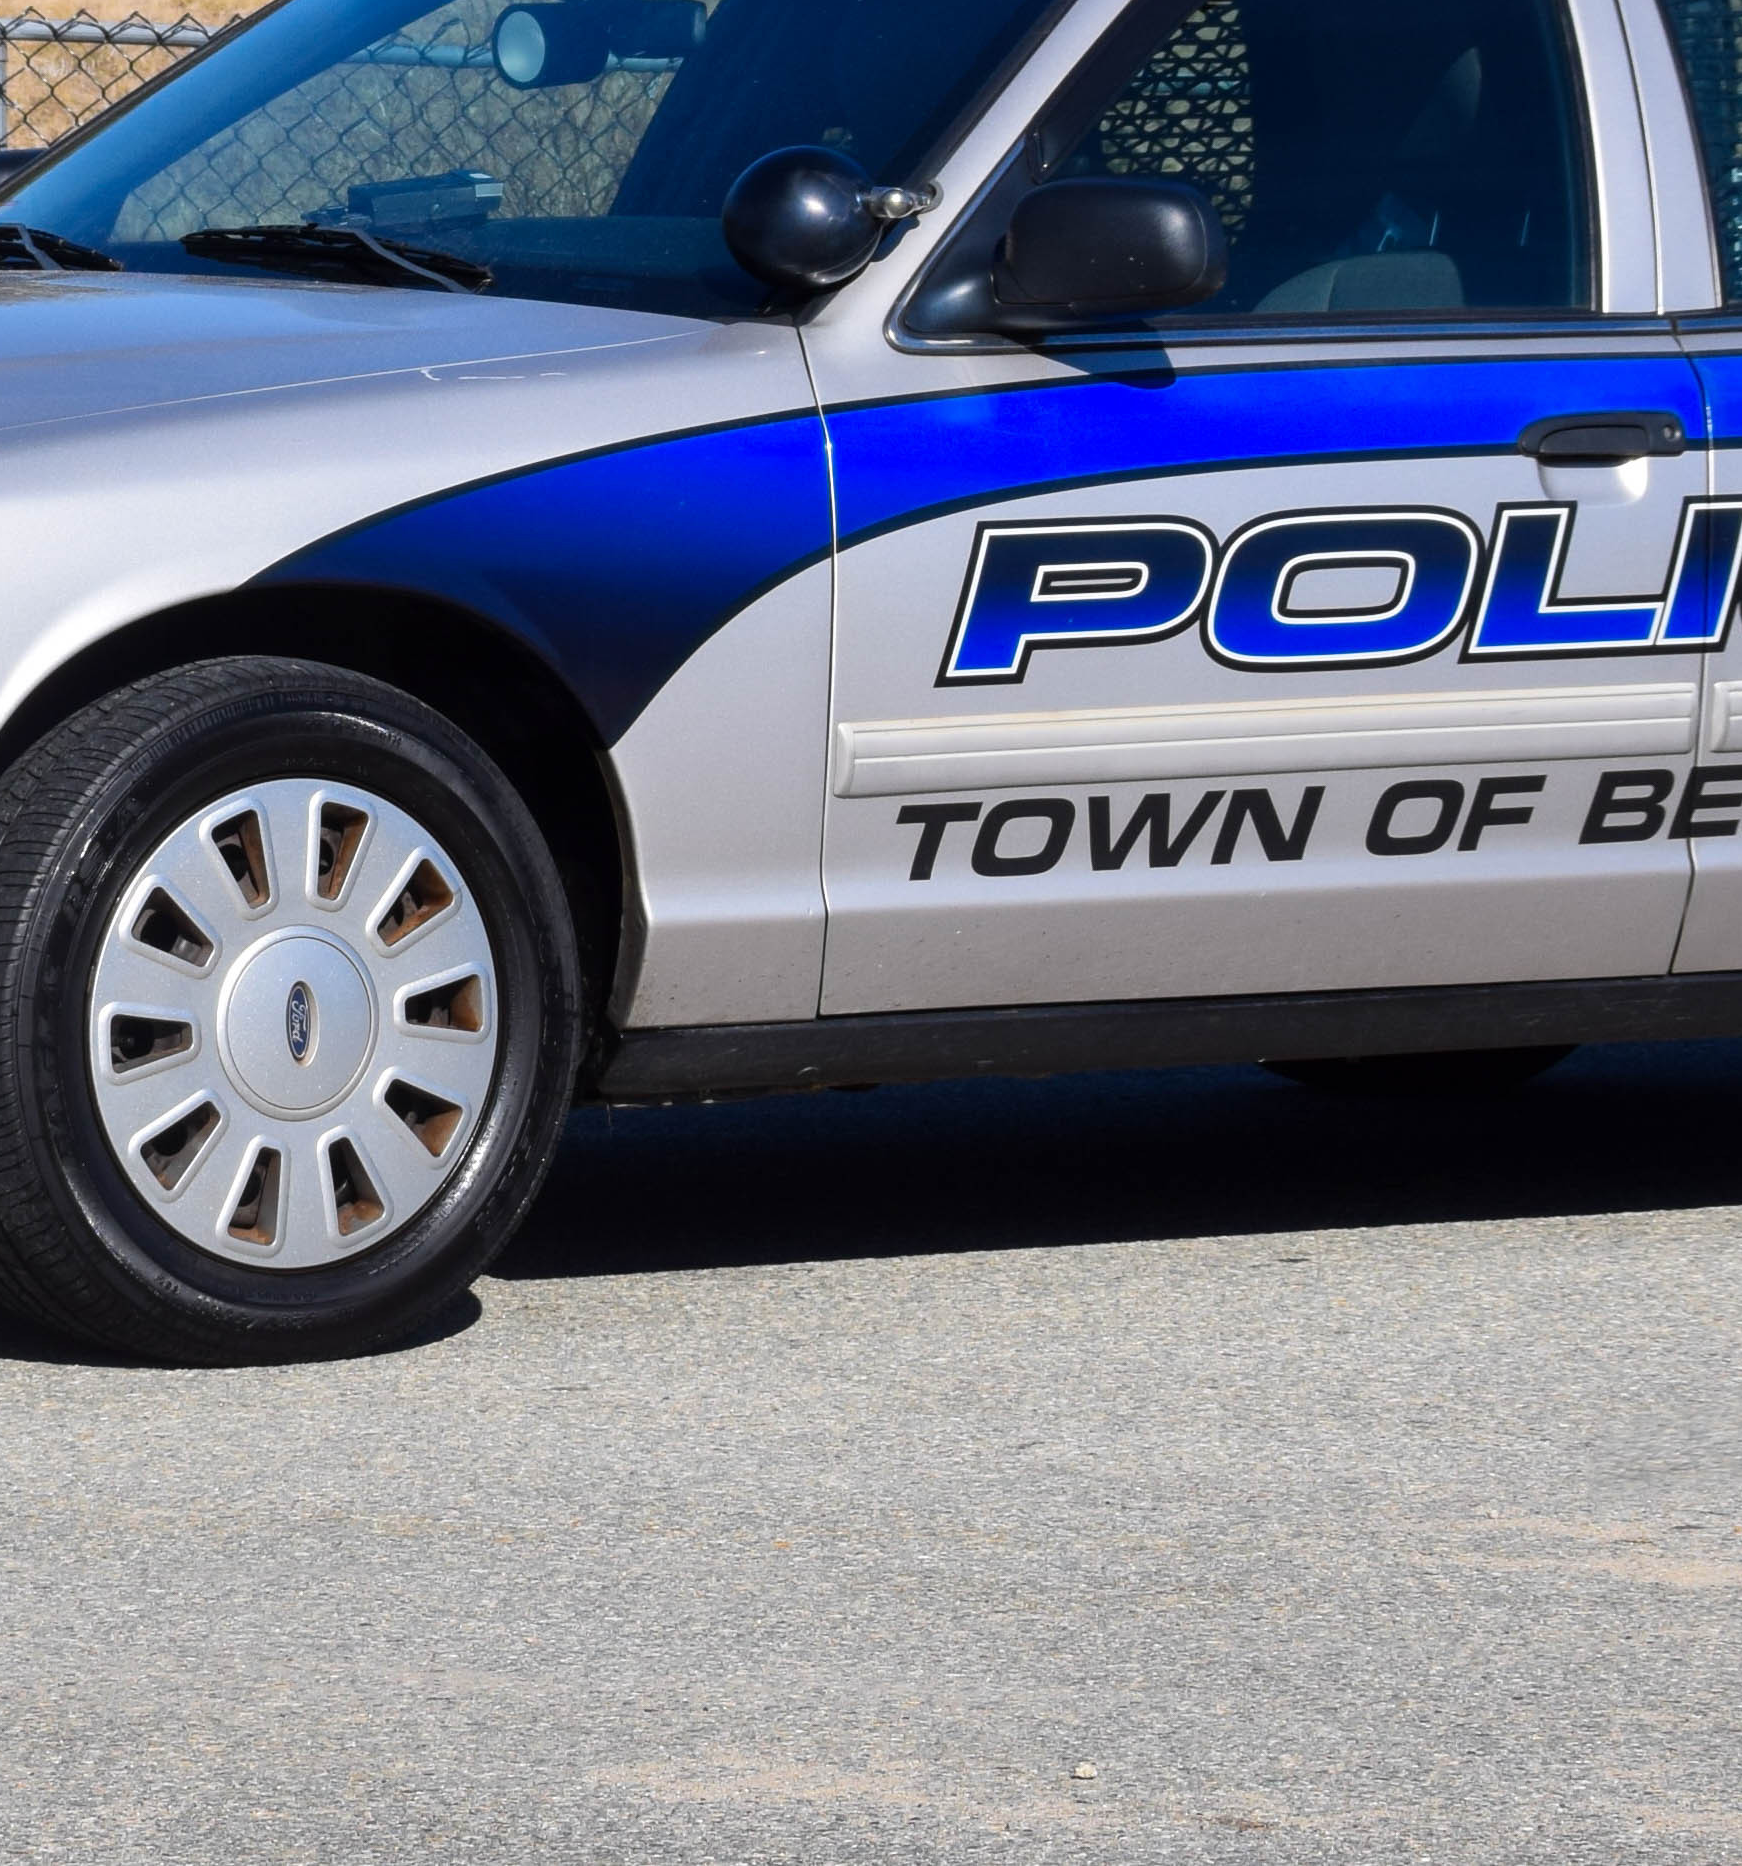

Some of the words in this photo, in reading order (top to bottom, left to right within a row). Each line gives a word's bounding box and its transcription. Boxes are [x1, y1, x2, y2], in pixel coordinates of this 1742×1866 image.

[895, 785, 1326, 881] TOWN
[1364, 774, 1548, 857] OF
[291, 1000, 307, 1043] Ford
